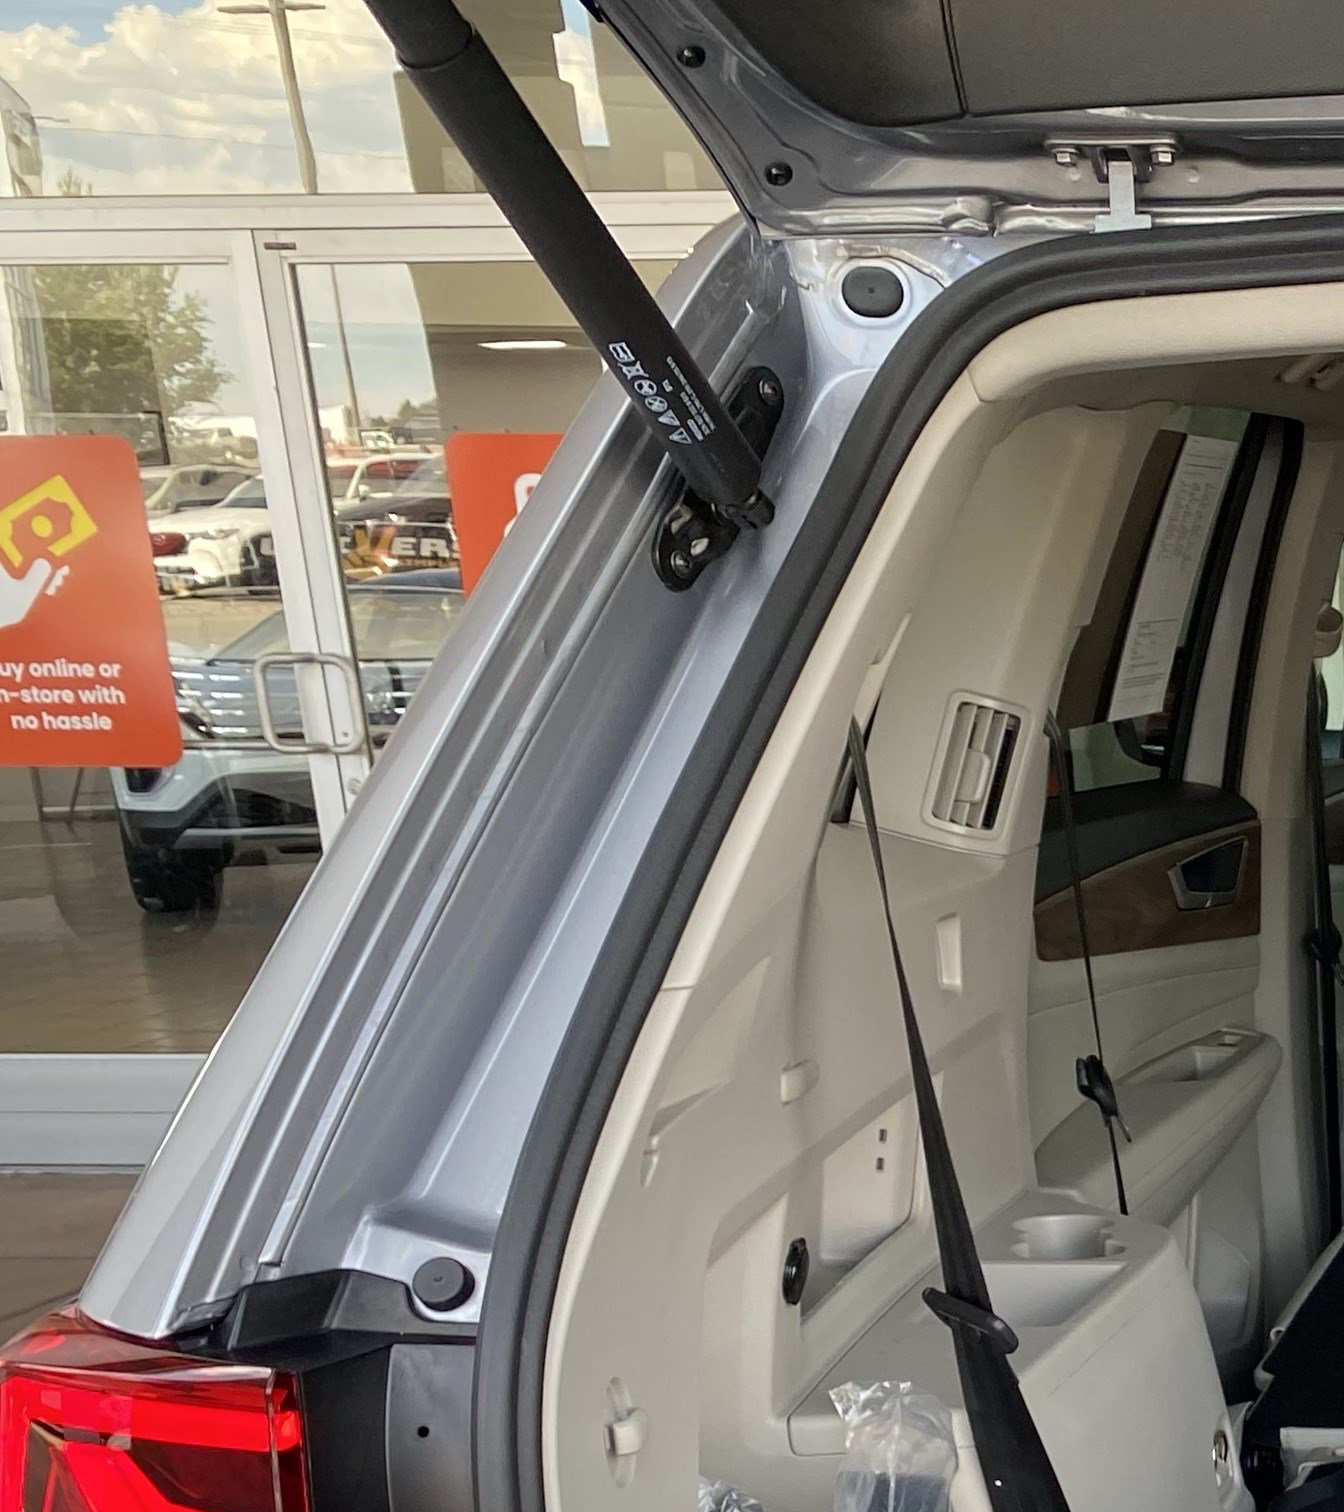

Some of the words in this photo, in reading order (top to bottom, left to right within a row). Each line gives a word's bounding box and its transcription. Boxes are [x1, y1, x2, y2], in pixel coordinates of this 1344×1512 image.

[0, 661, 24, 683] uy
[29, 658, 95, 678] online
[99, 662, 122, 678] or
[0, 685, 74, 705] n-store
[78, 684, 126, 705] with
[10, 714, 39, 730] no
[41, 711, 113, 731] hassle
